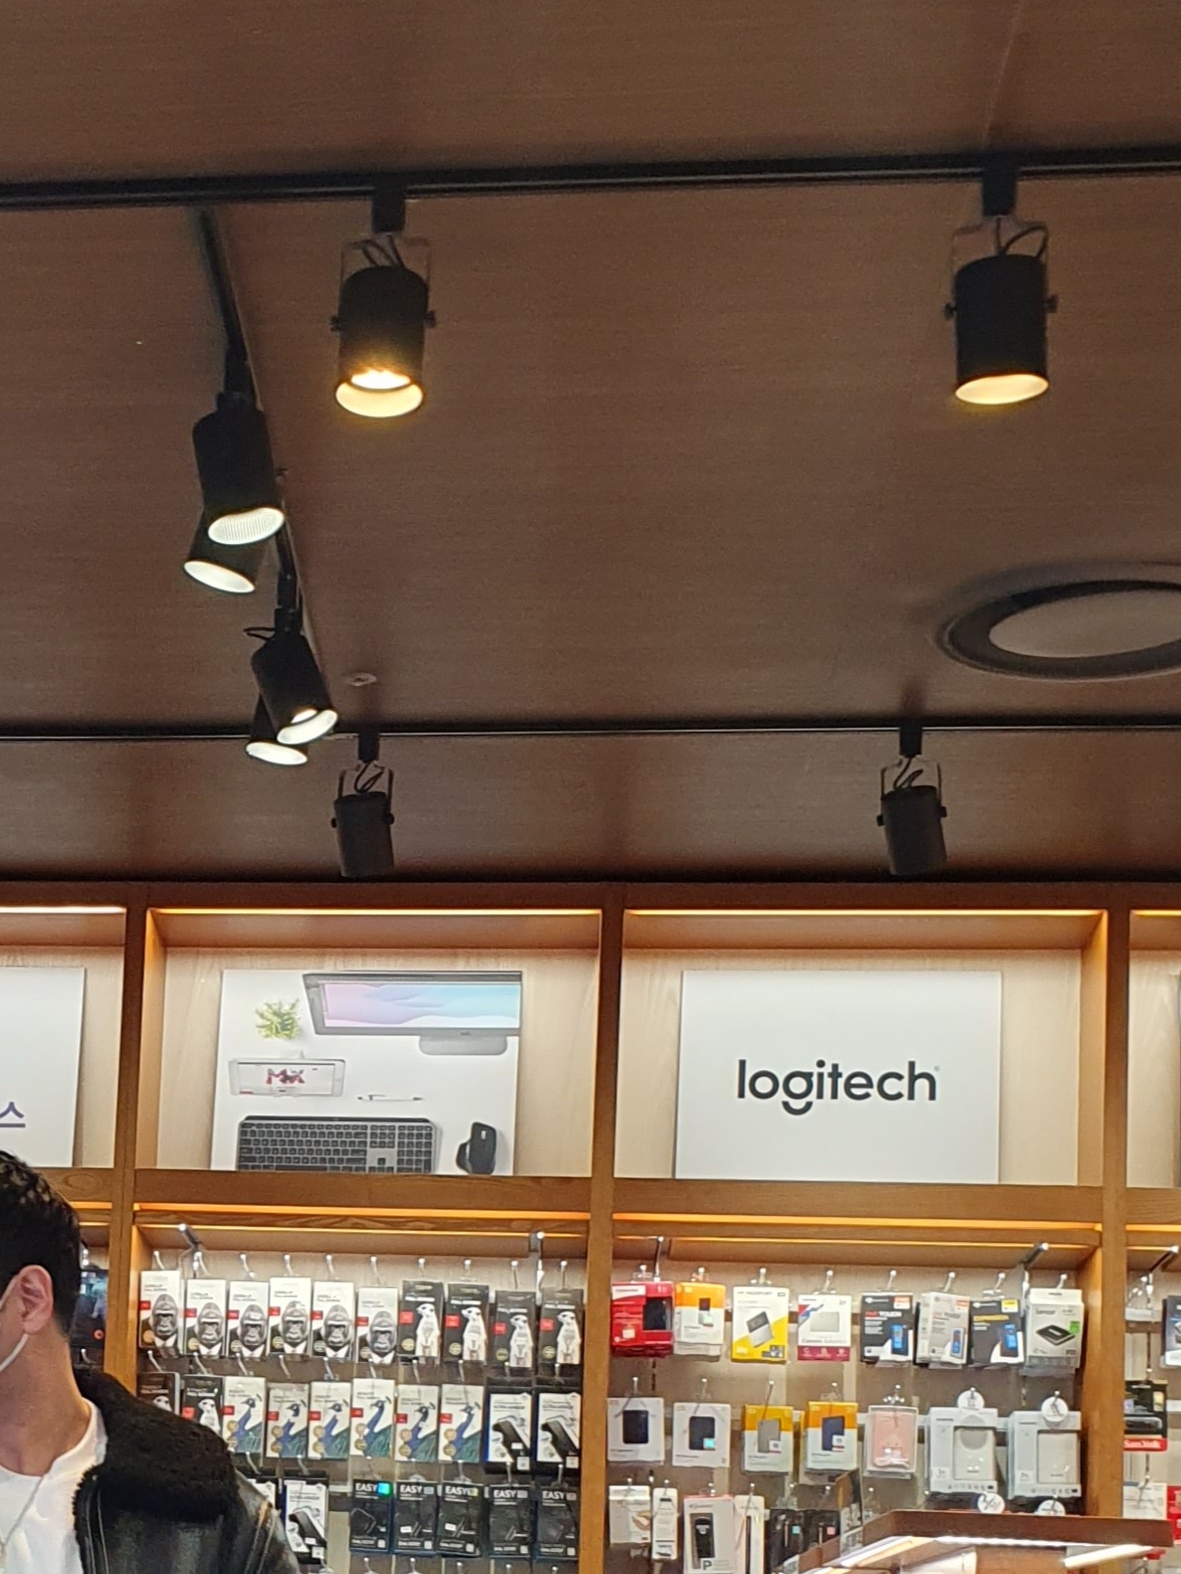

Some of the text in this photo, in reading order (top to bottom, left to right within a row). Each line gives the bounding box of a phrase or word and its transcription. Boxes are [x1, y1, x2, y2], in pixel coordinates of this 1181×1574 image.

[736, 1058, 938, 1116] logitech
[355, 1482, 377, 1492] EASY
[400, 1485, 422, 1493] EASY
[445, 1486, 468, 1494] EASY
[493, 1489, 517, 1498] EASY
[542, 1490, 564, 1499] EASY
